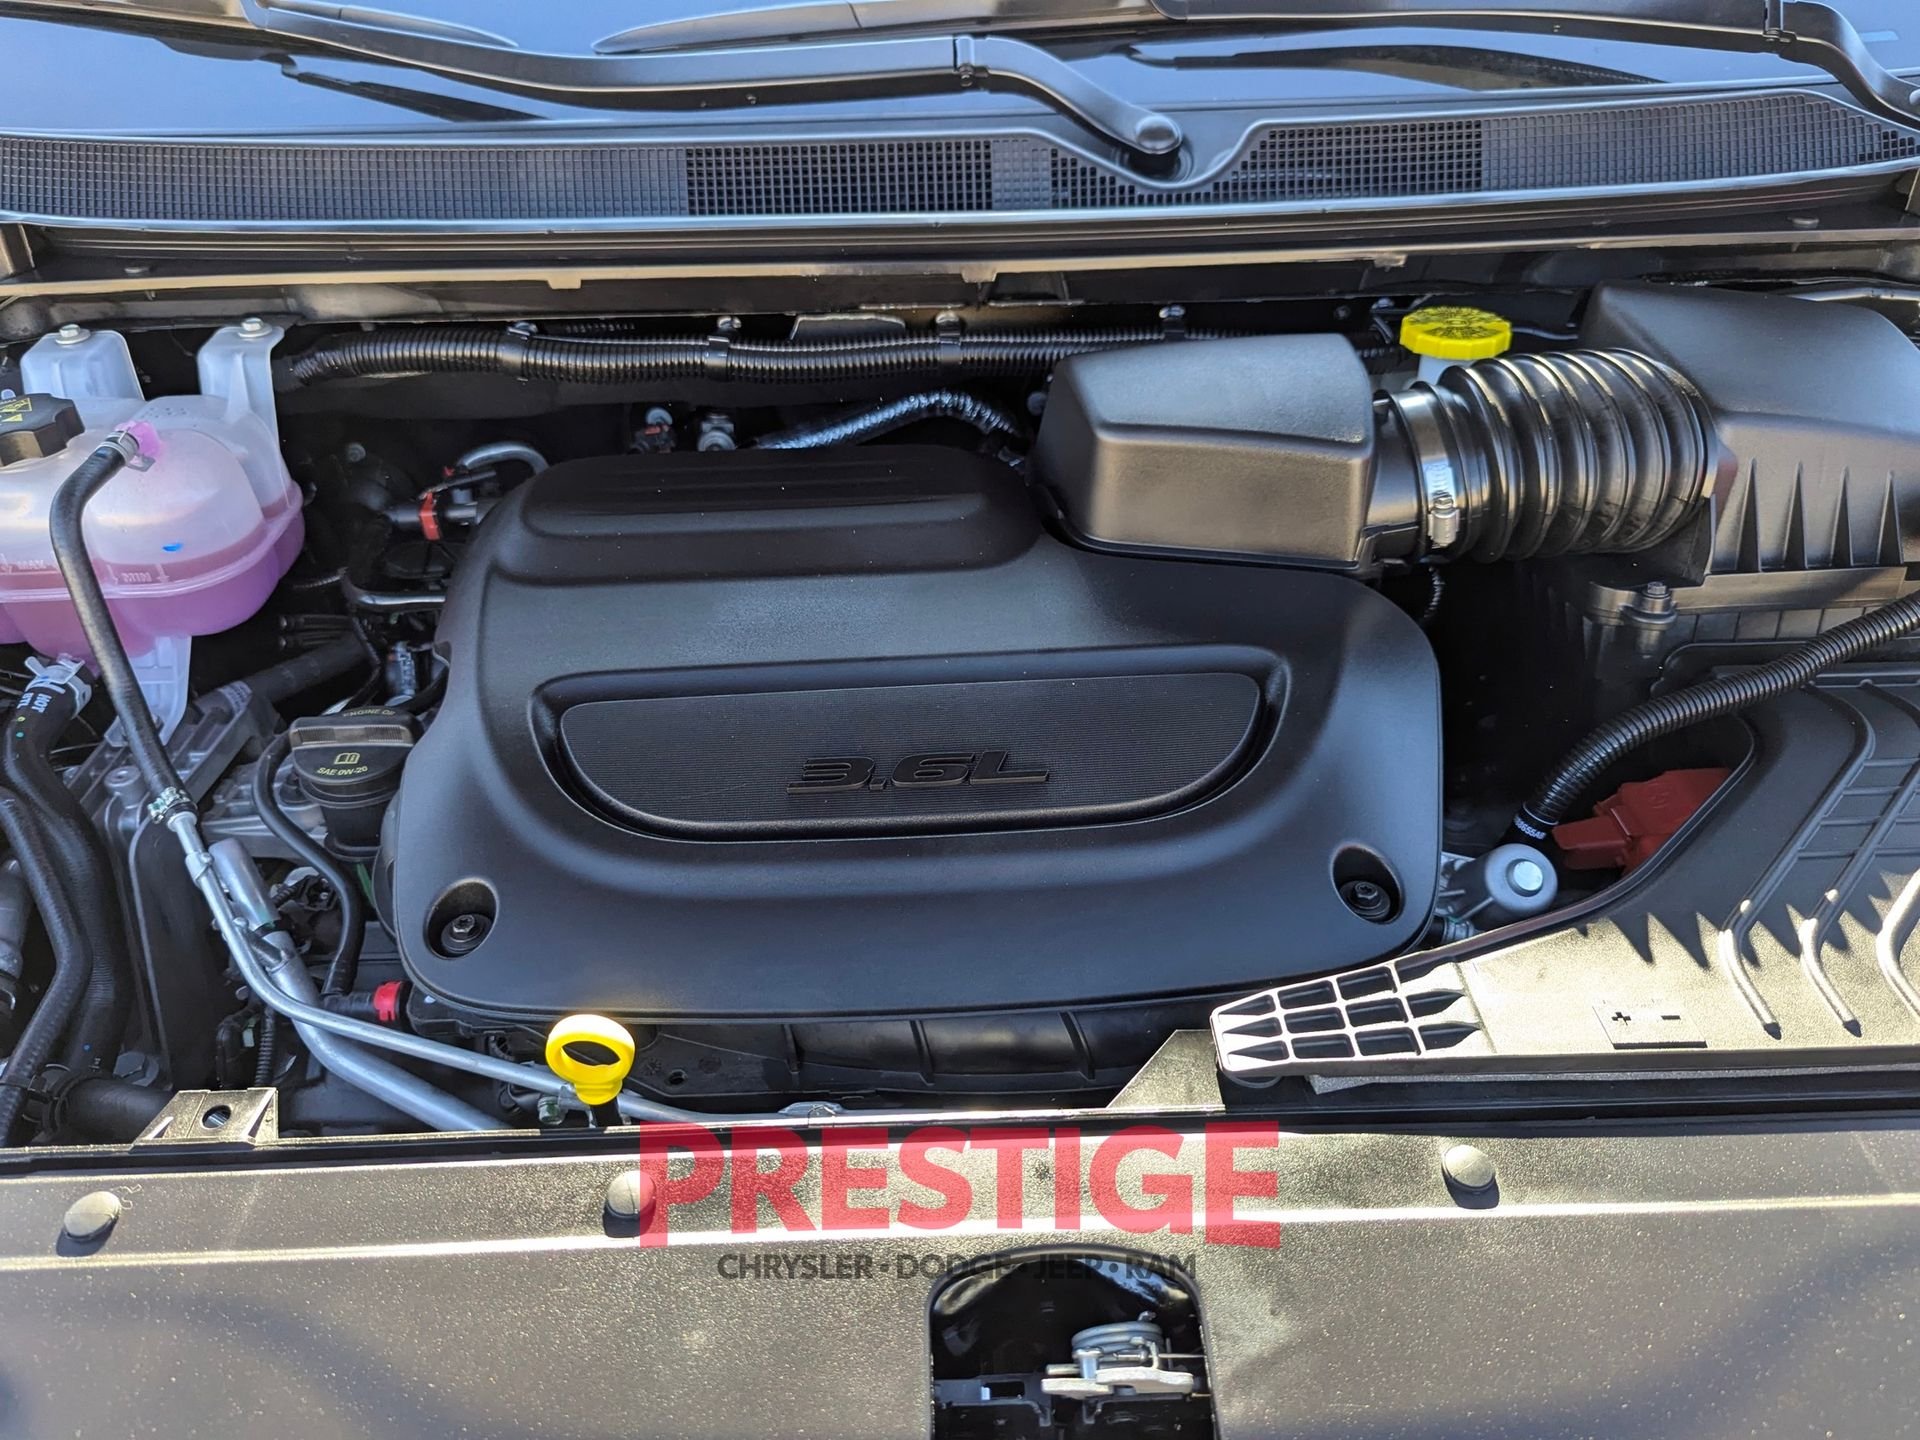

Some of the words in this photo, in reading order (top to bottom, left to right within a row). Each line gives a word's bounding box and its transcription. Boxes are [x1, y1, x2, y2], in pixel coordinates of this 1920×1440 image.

[31, 693, 52, 713] HOT
[317, 767, 337, 776] SAE
[337, 765, 368, 776] 0W-20
[786, 750, 1049, 795] 3.6L
